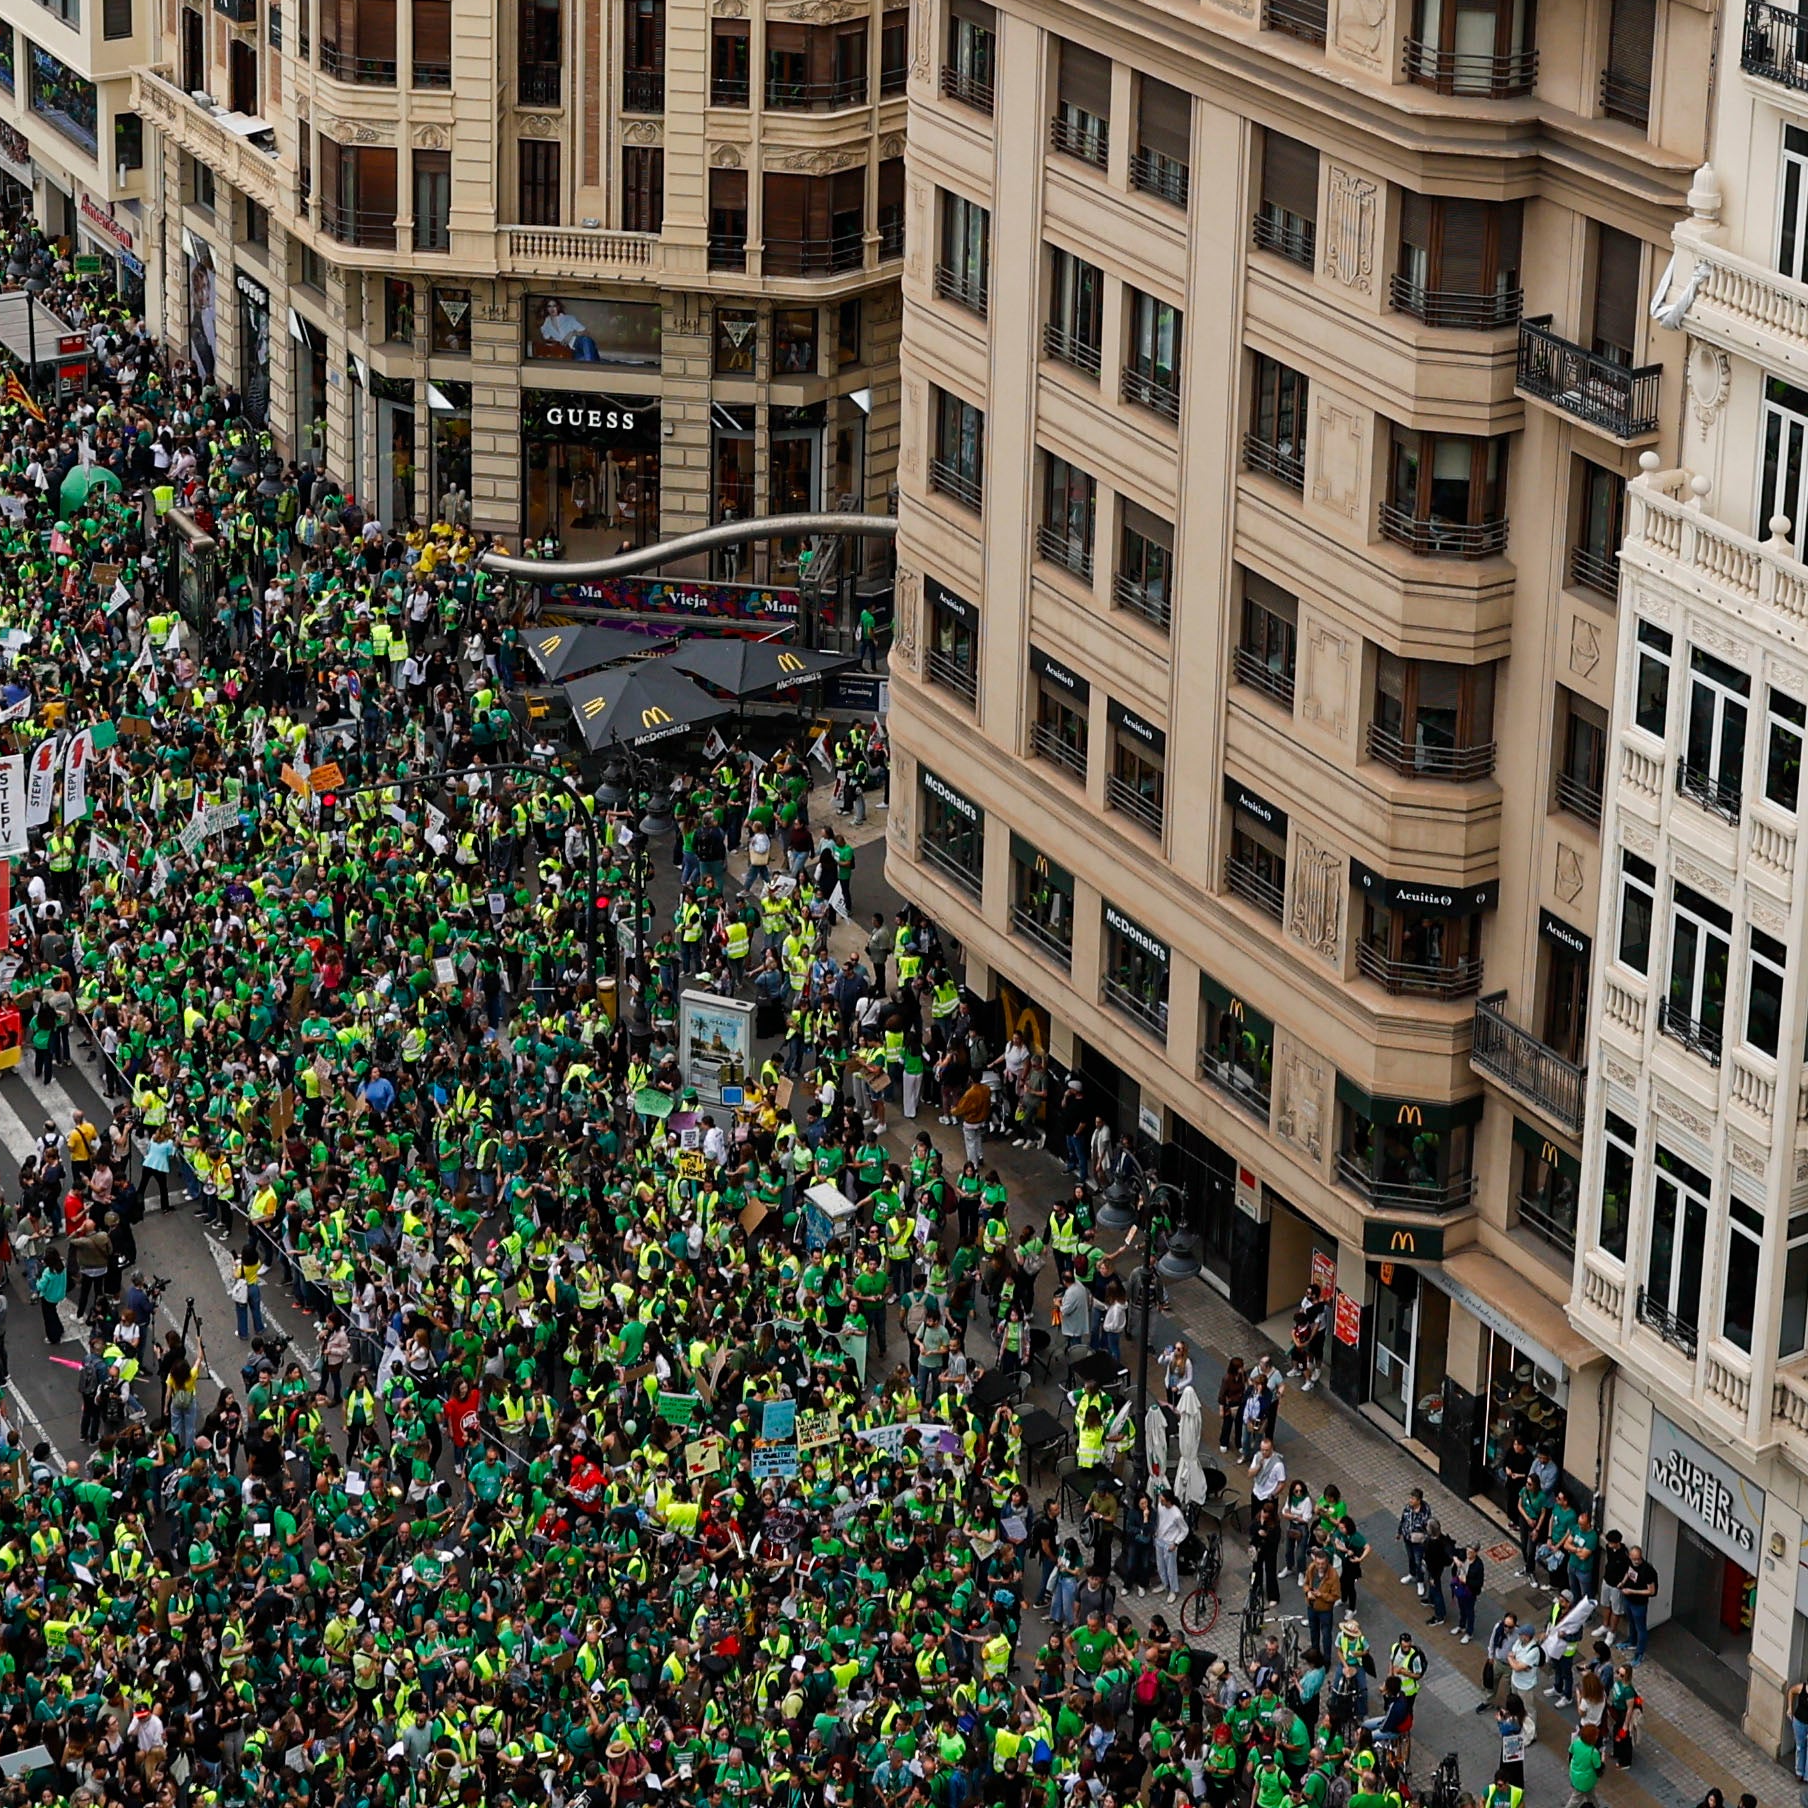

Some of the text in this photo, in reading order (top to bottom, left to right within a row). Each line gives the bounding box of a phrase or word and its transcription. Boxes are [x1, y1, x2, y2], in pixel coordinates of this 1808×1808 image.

[237, 276, 266, 305] GUESS
[546, 407, 635, 430] GUESS
[579, 585, 602, 599] Ma
[669, 592, 708, 608] Vieja
[776, 671, 822, 691] McDonald's
[634, 722, 691, 746] McDonald's
[30, 774, 43, 807] STEPV
[68, 772, 77, 802] STEPV
[924, 772, 977, 821] McDonald's
[0, 772, 11, 843] STEPV
[1238, 793, 1265, 819] Acuitis
[1396, 888, 1440, 904] Acuitis
[1106, 908, 1167, 962] McDonald's
[1546, 921, 1575, 946] Acuitis
[869, 1429, 902, 1443] CEIP
